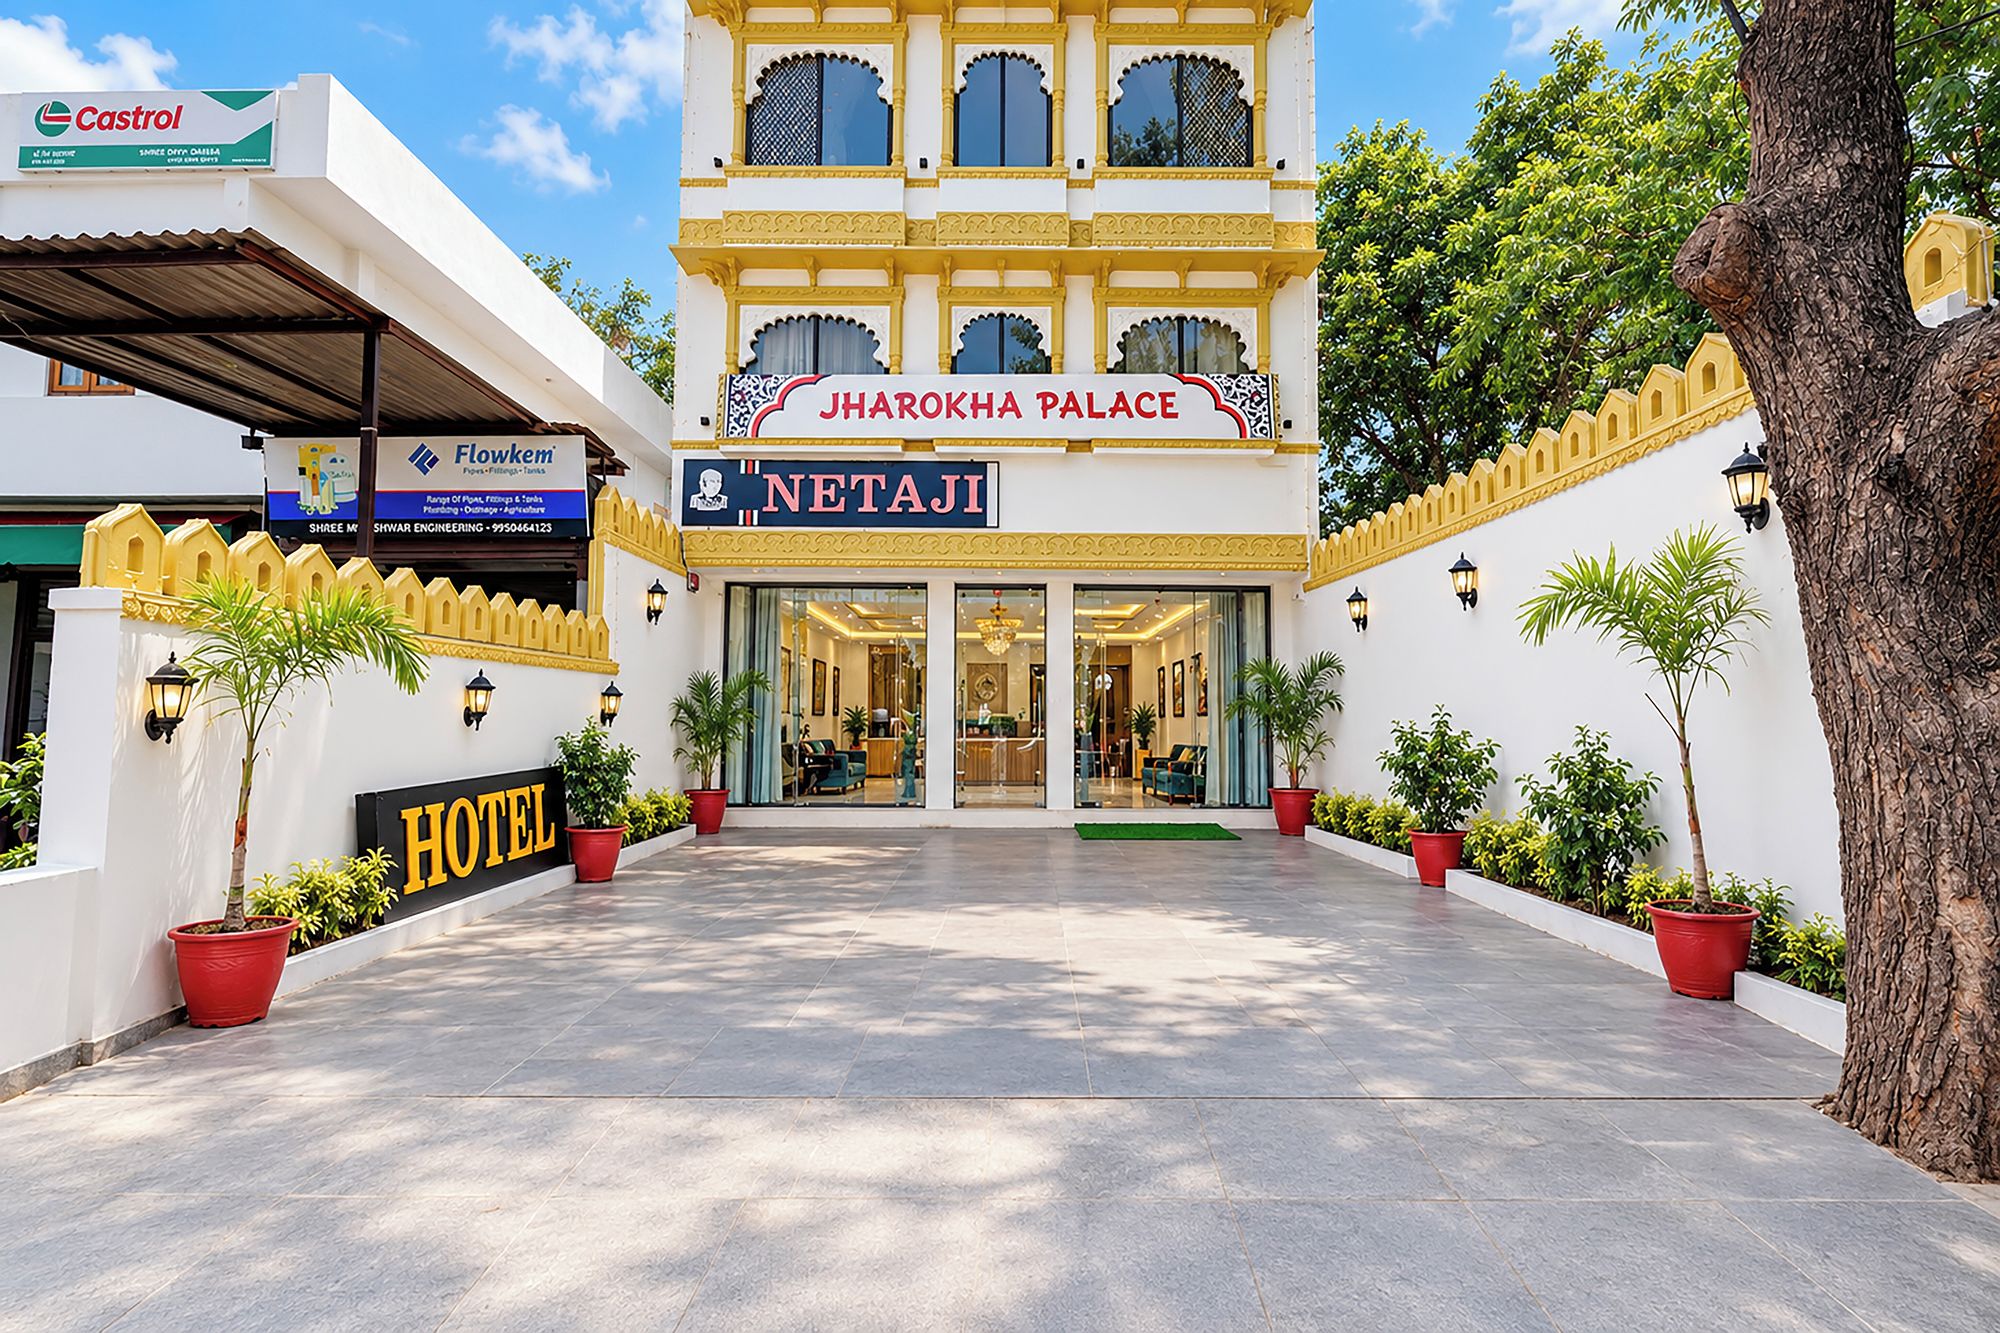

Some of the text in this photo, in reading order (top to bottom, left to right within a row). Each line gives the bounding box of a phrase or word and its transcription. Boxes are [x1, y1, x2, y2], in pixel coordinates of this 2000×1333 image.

[75, 104, 183, 132] Castrol
[819, 391, 1179, 420] JHAROKHA PALACE
[455, 443, 553, 464] Flowkem
[762, 474, 985, 514] NETAJI
[309, 523, 344, 533] SHREE
[414, 523, 484, 533] ENGINEERING
[401, 783, 556, 896] HOTEL
